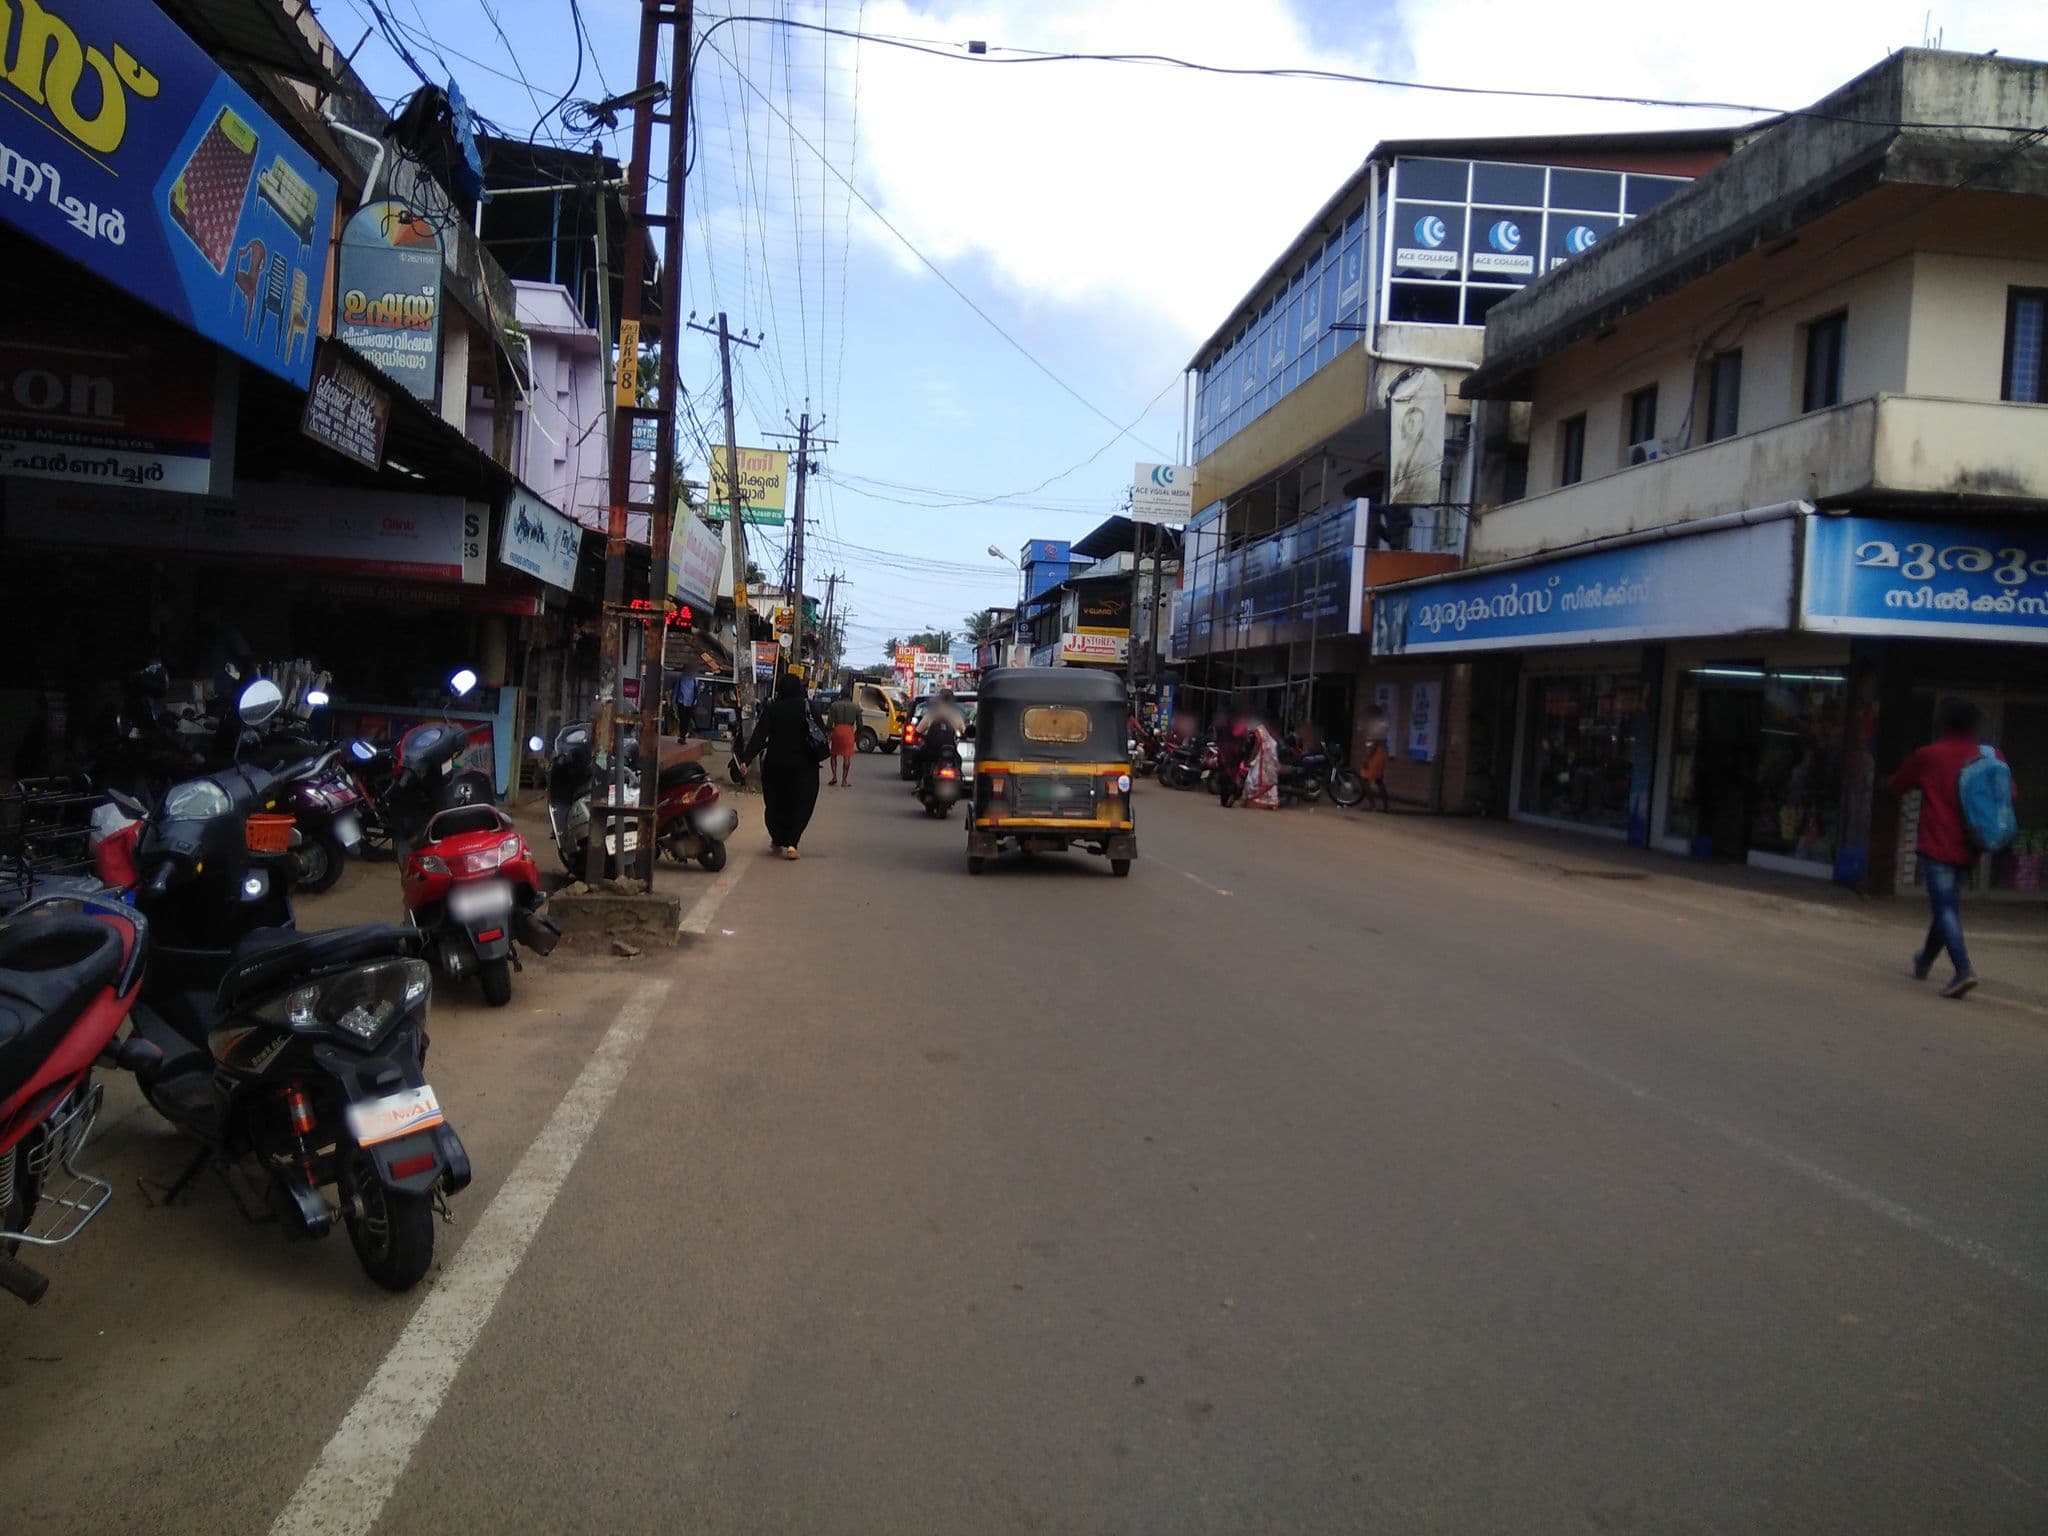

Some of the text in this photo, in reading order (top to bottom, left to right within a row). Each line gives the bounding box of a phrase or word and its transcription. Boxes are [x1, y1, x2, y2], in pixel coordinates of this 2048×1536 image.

[1399, 252, 1454, 263] ACE COLLEGE
[1475, 256, 1530, 267] ACE COLLEGE
[622, 372, 632, 389] 8
[1136, 486, 1148, 494] ACE
[1087, 636, 1117, 646] STORES
